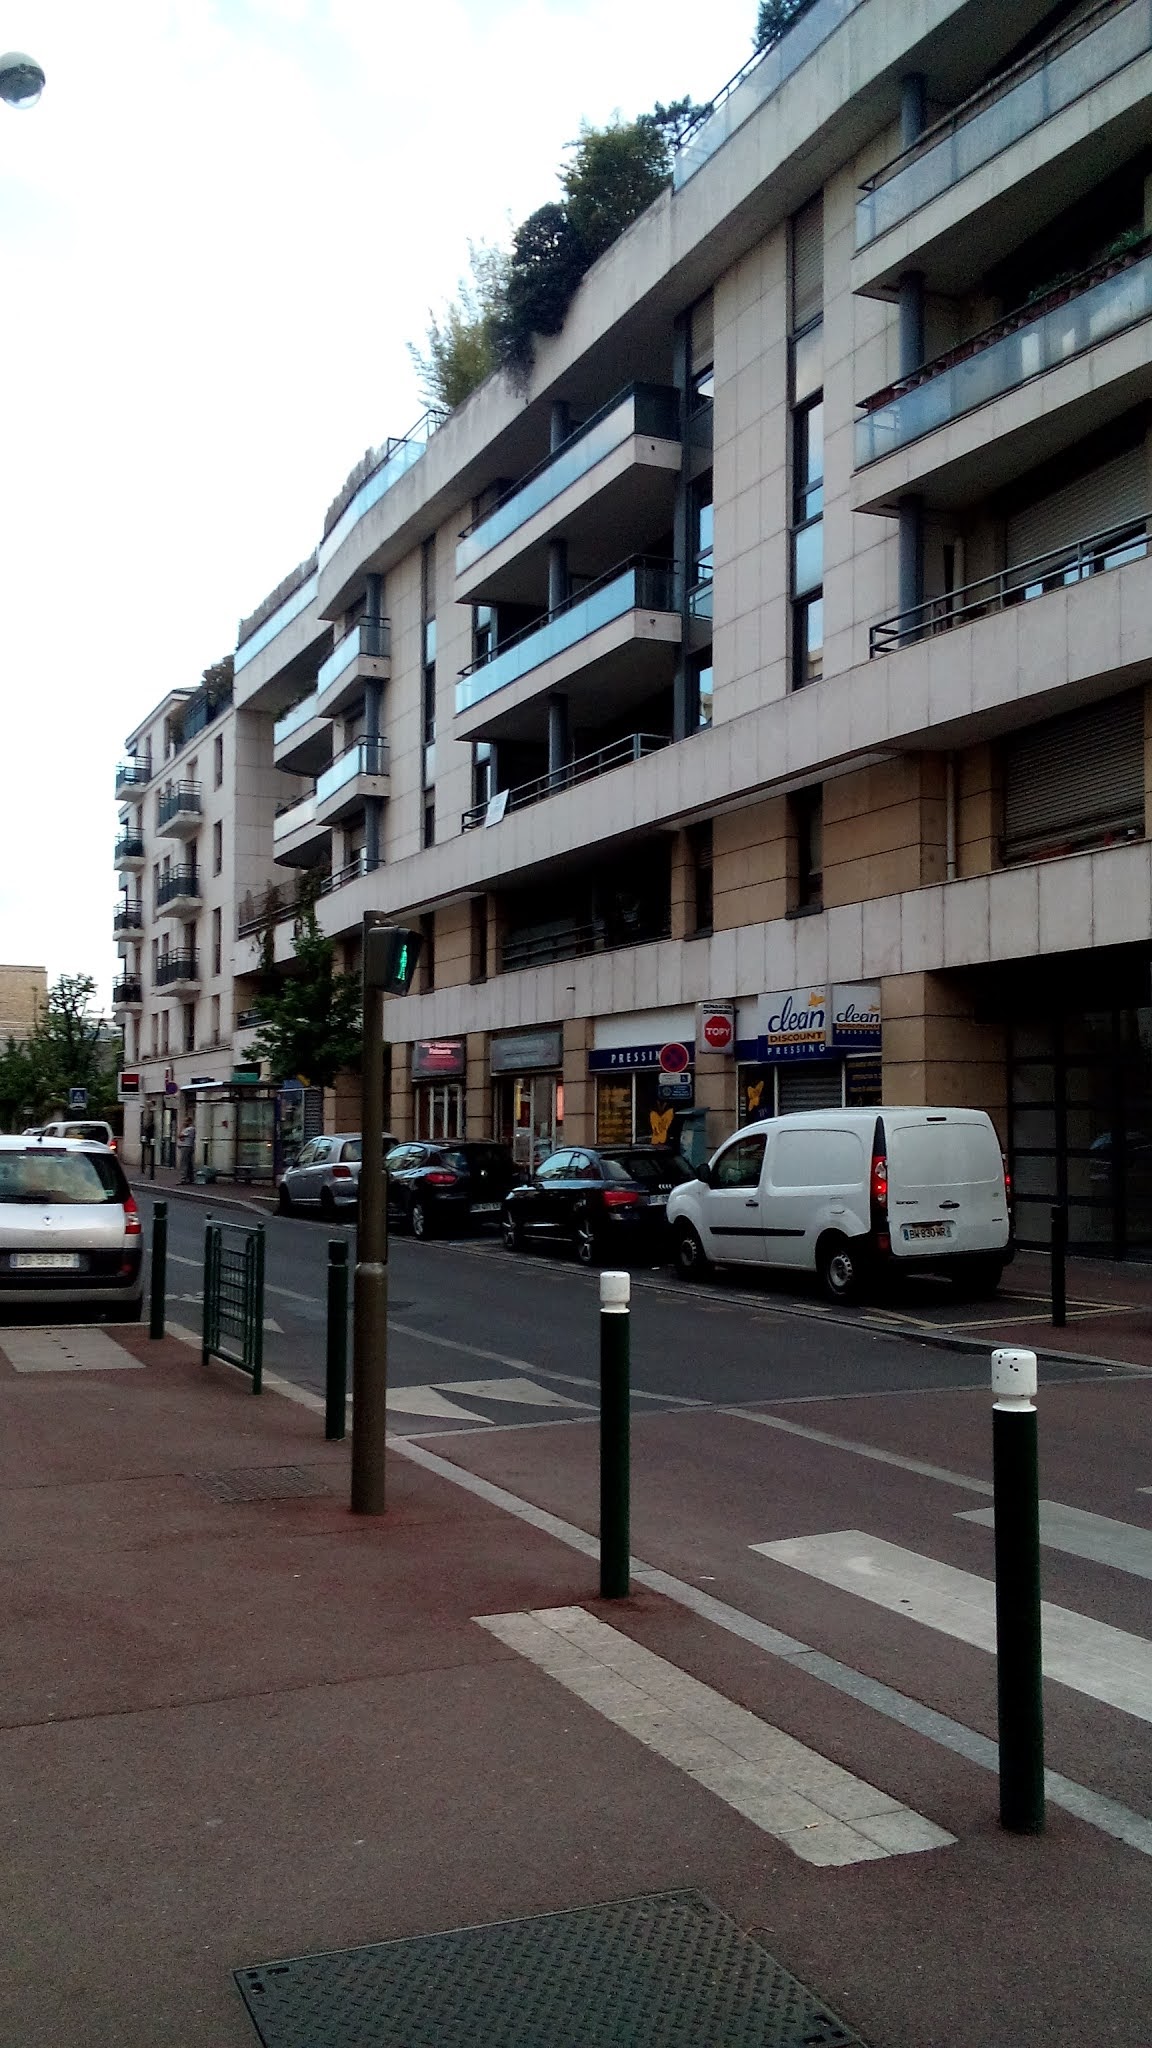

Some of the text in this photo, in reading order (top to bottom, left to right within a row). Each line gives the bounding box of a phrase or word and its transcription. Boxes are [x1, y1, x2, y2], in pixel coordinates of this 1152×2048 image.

[768, 996, 825, 1033] clean
[836, 1003, 879, 1023] clean
[706, 1027, 730, 1036] TOPY
[770, 1032, 823, 1043] DISCOUNT
[767, 1044, 826, 1056] PRESSING
